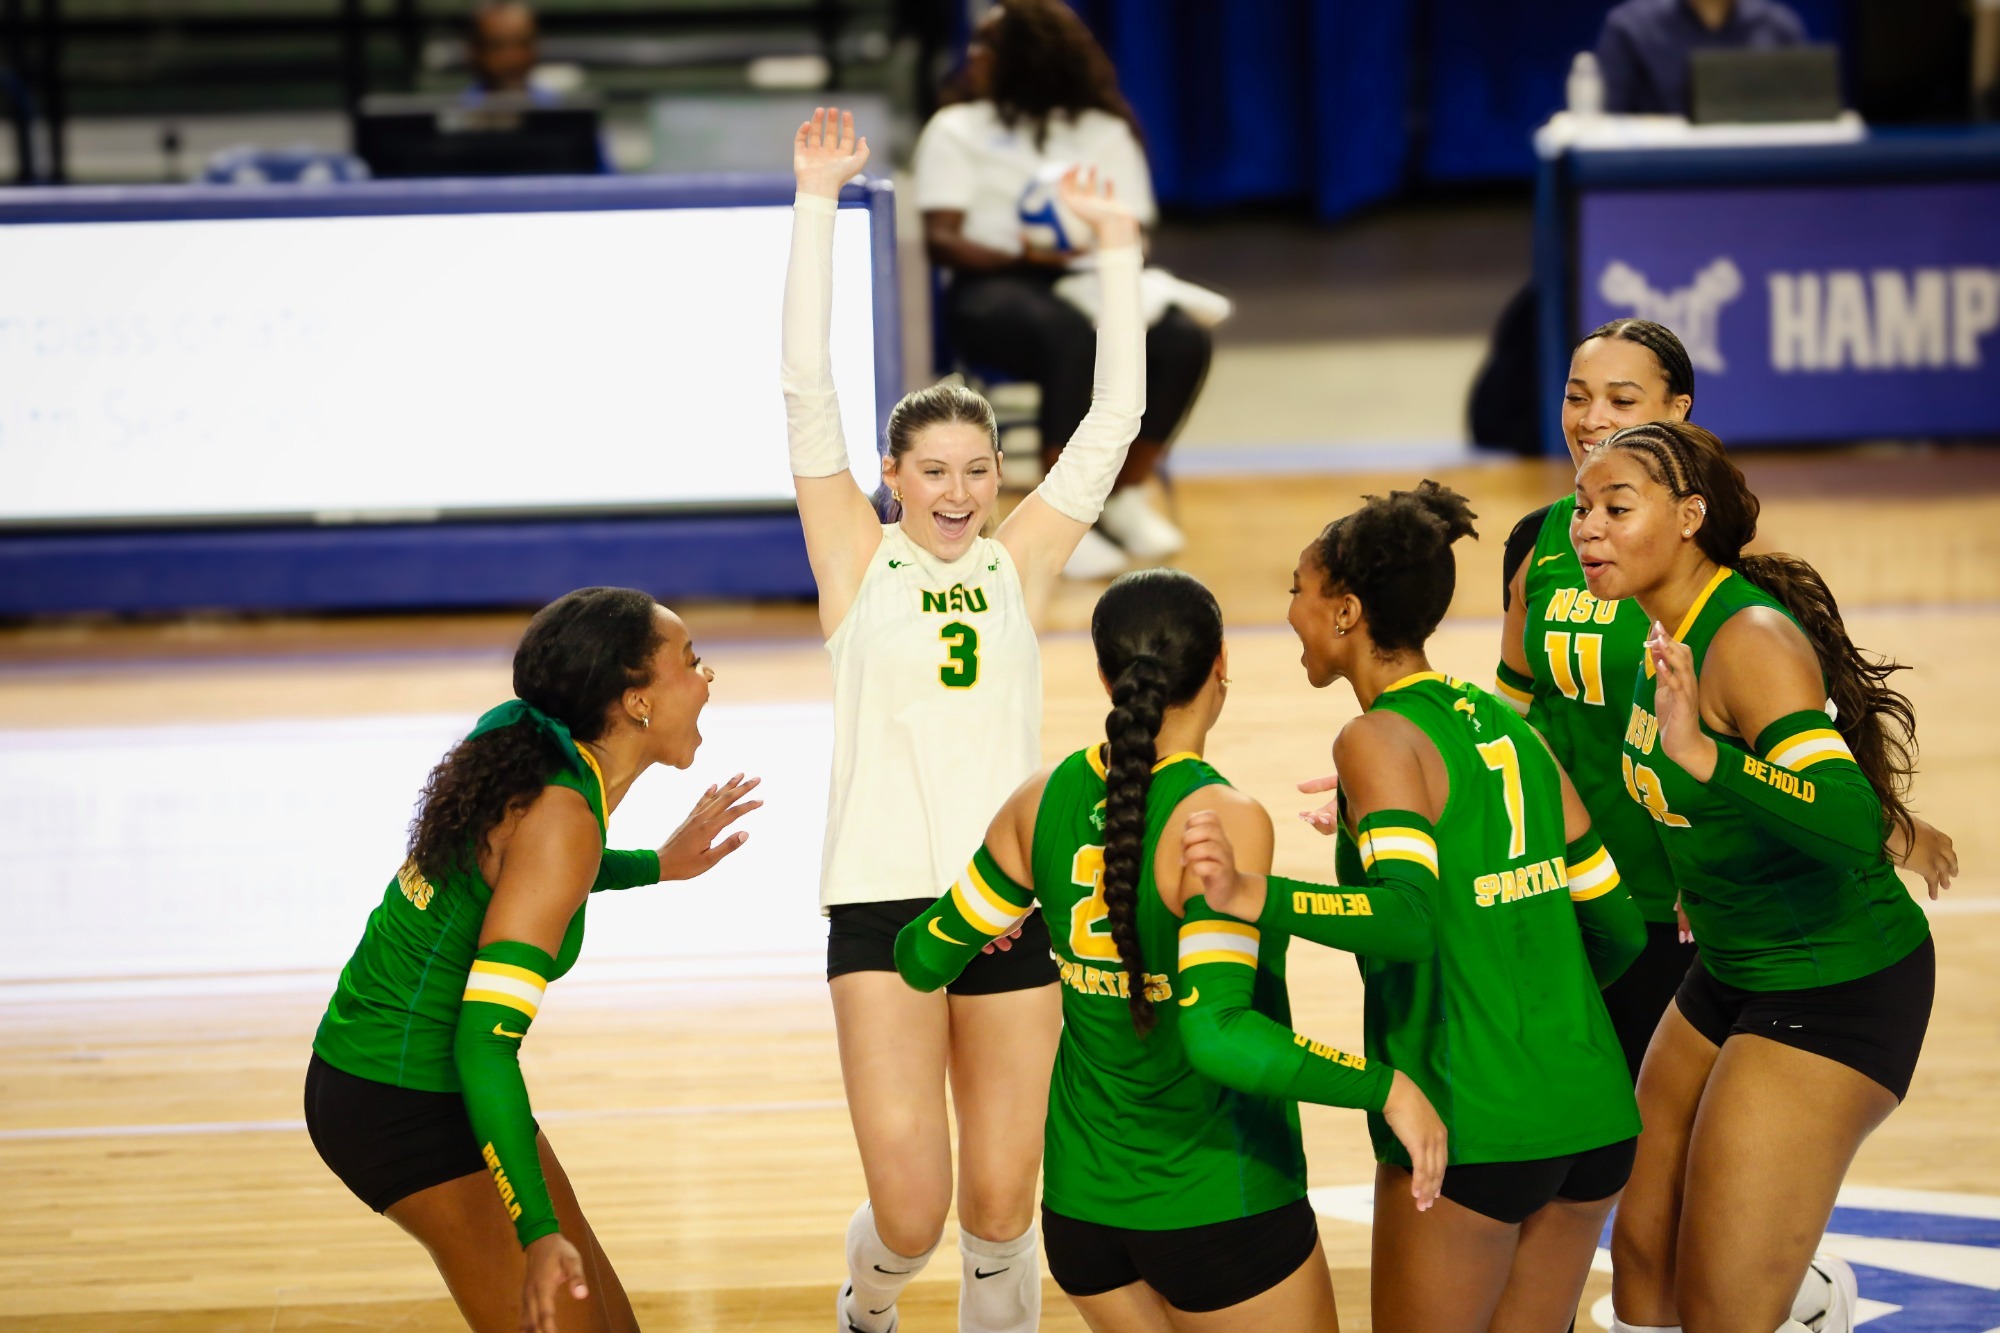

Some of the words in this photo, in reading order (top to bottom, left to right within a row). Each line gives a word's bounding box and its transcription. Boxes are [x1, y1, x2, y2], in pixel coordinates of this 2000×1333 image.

[1769, 267, 2000, 373] HAMP
[920, 582, 988, 613] NSU
[1545, 588, 1619, 624] NSU
[938, 620, 981, 691] 3
[1544, 631, 1605, 706] 11
[1624, 703, 1658, 755] NSU
[1475, 735, 1526, 860] 7
[1622, 751, 1692, 827] 12
[1743, 755, 1815, 803] BEHOLD
[1069, 844, 1124, 963] 2
[1292, 891, 1374, 916] BEHOLD
[1293, 1033, 1367, 1072] BEHOLD
[481, 1140, 523, 1222] BEHOLD
